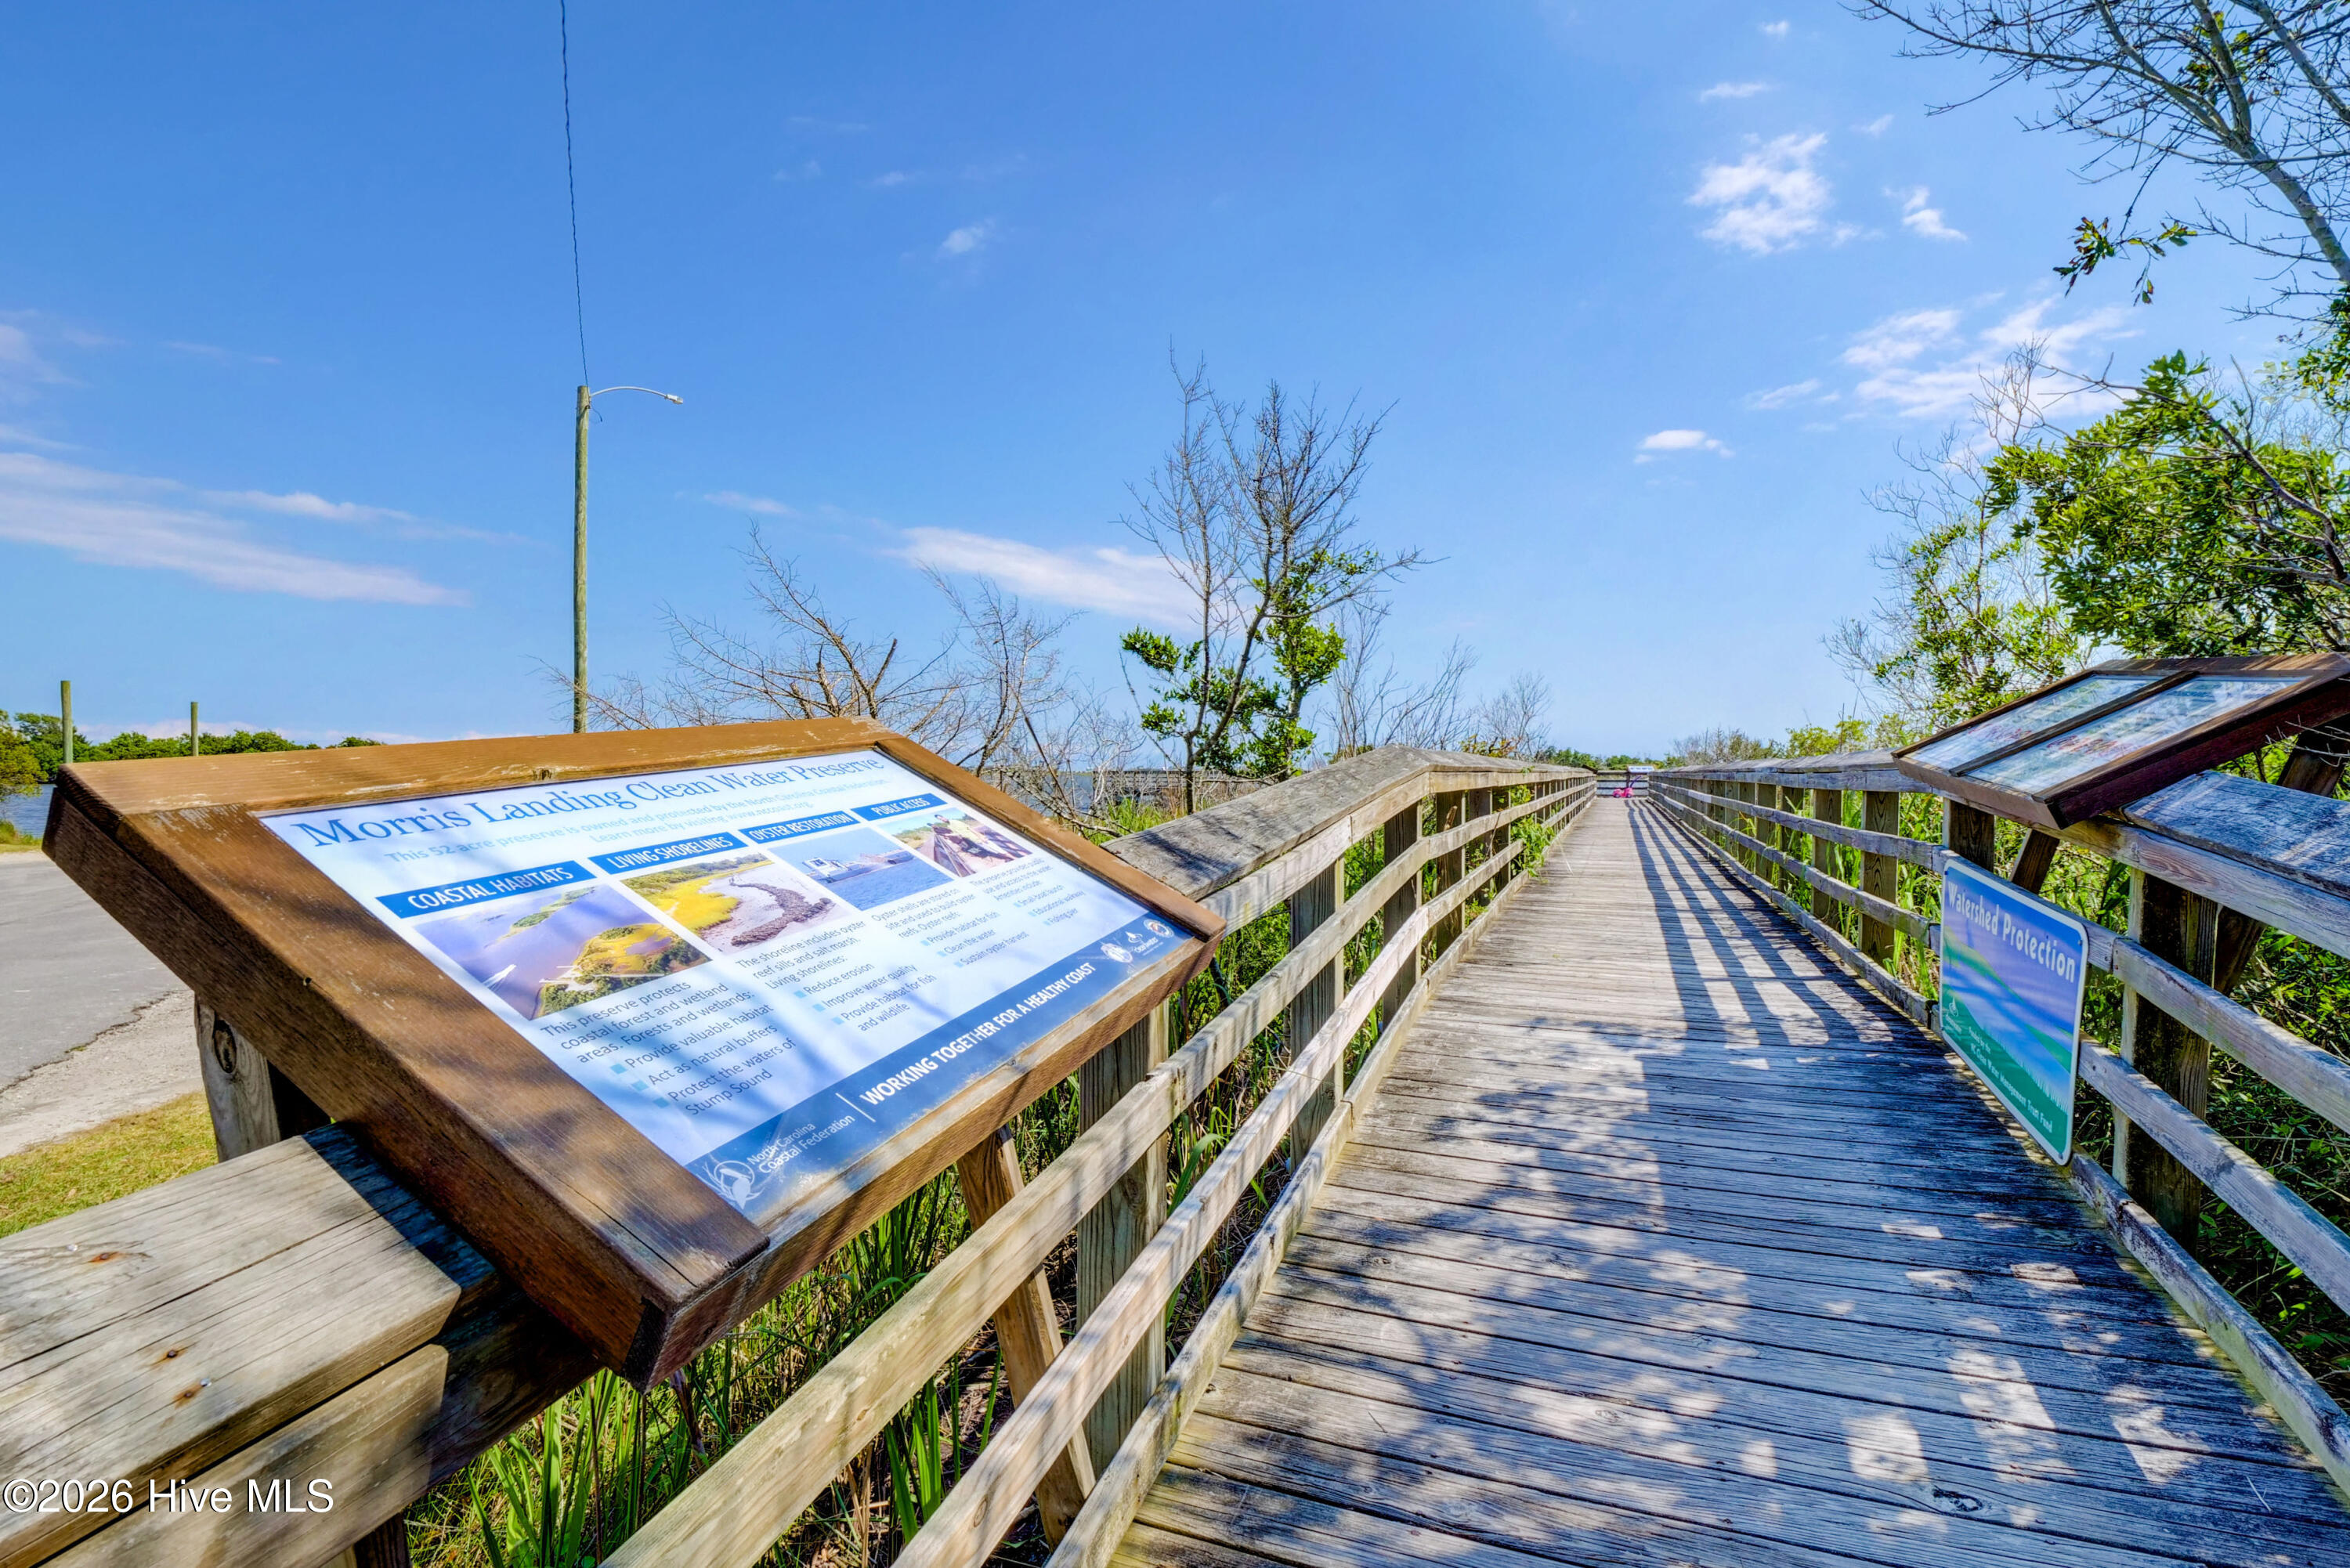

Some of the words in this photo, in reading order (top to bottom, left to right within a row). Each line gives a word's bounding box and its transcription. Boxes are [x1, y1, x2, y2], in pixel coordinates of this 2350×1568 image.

[291, 807, 471, 846] Morris
[465, 791, 637, 822] Landing
[626, 782, 719, 800] Clean
[707, 771, 795, 789] Water
[786, 760, 884, 779] Preserve
[871, 804, 904, 815] PUBLIC
[895, 798, 930, 810] ACCESS
[384, 851, 429, 862] This
[428, 845, 457, 855] 52
[456, 841, 495, 851] acre
[496, 830, 566, 847] preserve
[580, 818, 628, 831] owned
[629, 815, 655, 823] and
[655, 805, 713, 821] protected
[589, 832, 632, 843] Learn
[631, 826, 667, 836] more
[664, 823, 685, 832] by
[685, 816, 728, 826] visiting
[750, 826, 793, 840] OYSTER
[786, 815, 852, 832] RESTORATION
[607, 851, 660, 868] LIVING
[655, 837, 732, 858] SHORELINES
[408, 884, 497, 909] COASTAL
[490, 868, 573, 892] HABITATS
[735, 959, 760, 968] The
[759, 943, 805, 961] shoreline
[801, 930, 841, 945] includes
[841, 921, 866, 933] oyster
[1948, 881, 1999, 936] Watershed
[2002, 913, 2075, 983] Protection
[753, 965, 776, 979] reef
[775, 960, 795, 970] sills
[794, 952, 814, 963] and
[812, 947, 832, 956] salt
[830, 938, 861, 950] marsh.
[765, 974, 801, 988] Living
[797, 956, 848, 977] shorelines:
[803, 977, 842, 994] Reduce
[841, 963, 875, 980] erosion
[540, 1022, 577, 1035] This
[577, 1001, 638, 1027] preserve
[638, 982, 691, 1006] protects
[822, 988, 864, 1007] Improve
[862, 976, 888, 990] water
[888, 965, 918, 980] quality
[841, 1002, 879, 1020] Provide
[874, 987, 910, 1004] habitat
[905, 981, 920, 990] for
[917, 974, 937, 984] fish
[561, 1024, 614, 1050] coastal
[611, 1012, 655, 1031] forest
[654, 1000, 680, 1015] and
[679, 983, 728, 1005] wetland
[577, 1043, 624, 1063] areas.
[620, 1023, 672, 1045] Forests
[672, 1011, 698, 1026] and
[697, 992, 755, 1015] wetlands:
[625, 1043, 680, 1068] Provide
[678, 1022, 733, 1046] valuable
[728, 1004, 774, 1024] habitat
[859, 1017, 879, 1031] and
[876, 1004, 910, 1021] wildlife
[859, 1057, 938, 1104] WORKING
[931, 1022, 1000, 1062] TOGETHER
[993, 1009, 1022, 1027] FOR
[1017, 1004, 1031, 1014] A
[1024, 979, 1070, 1008] HEALTHY
[1065, 963, 1095, 984] COAST
[649, 1070, 675, 1086] Act
[674, 1063, 692, 1073] as
[689, 1041, 737, 1067] natural
[732, 1023, 779, 1046] buffers
[667, 1073, 722, 1101] Protect
[718, 1065, 743, 1078] the
[742, 1046, 783, 1067] waters
[783, 1037, 796, 1049] of
[683, 1090, 733, 1115] Stump
[729, 1068, 772, 1093] Sound
[747, 1145, 779, 1165] North
[774, 1124, 816, 1147] Carolina
[758, 1145, 802, 1172] Coastal
[799, 1115, 855, 1149] Federation
